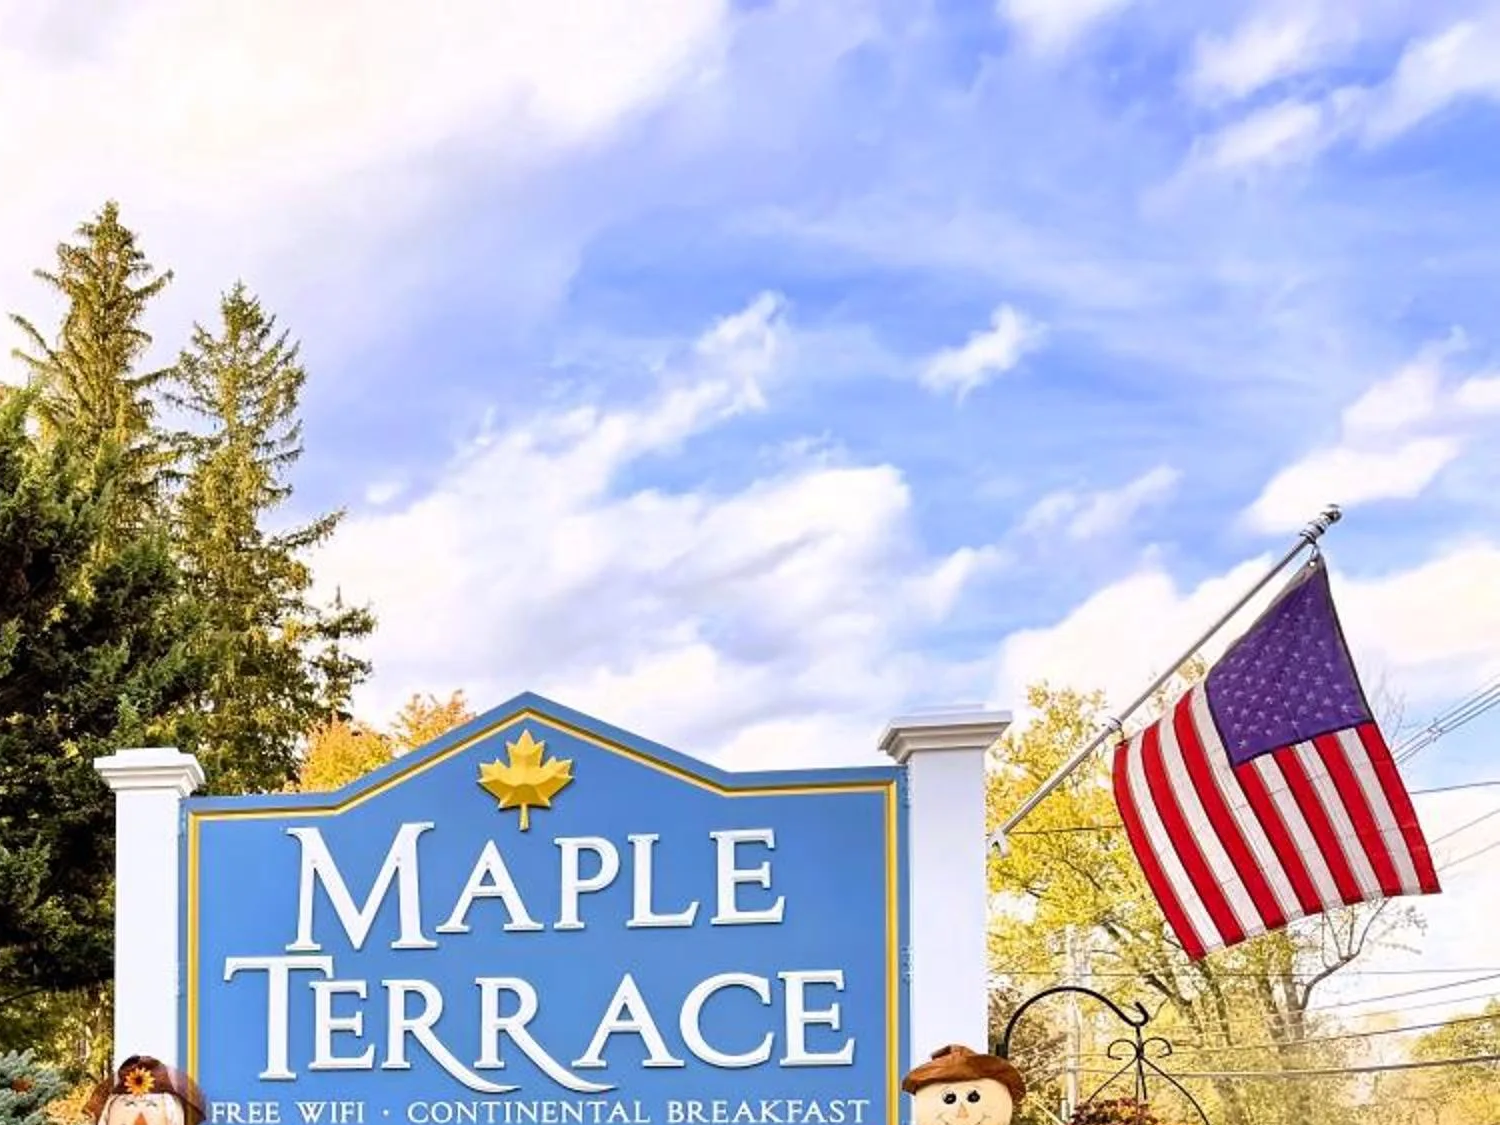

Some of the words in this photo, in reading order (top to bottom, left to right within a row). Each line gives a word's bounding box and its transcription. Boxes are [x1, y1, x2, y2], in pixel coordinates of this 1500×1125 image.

[286, 822, 786, 950] MAPLE
[224, 955, 856, 1093] TERRACE
[211, 1102, 281, 1124] FREE
[296, 1101, 366, 1124] WIFI
[407, 1100, 651, 1124] CONTINENTAL
[667, 1098, 871, 1124] BREAKFAST
